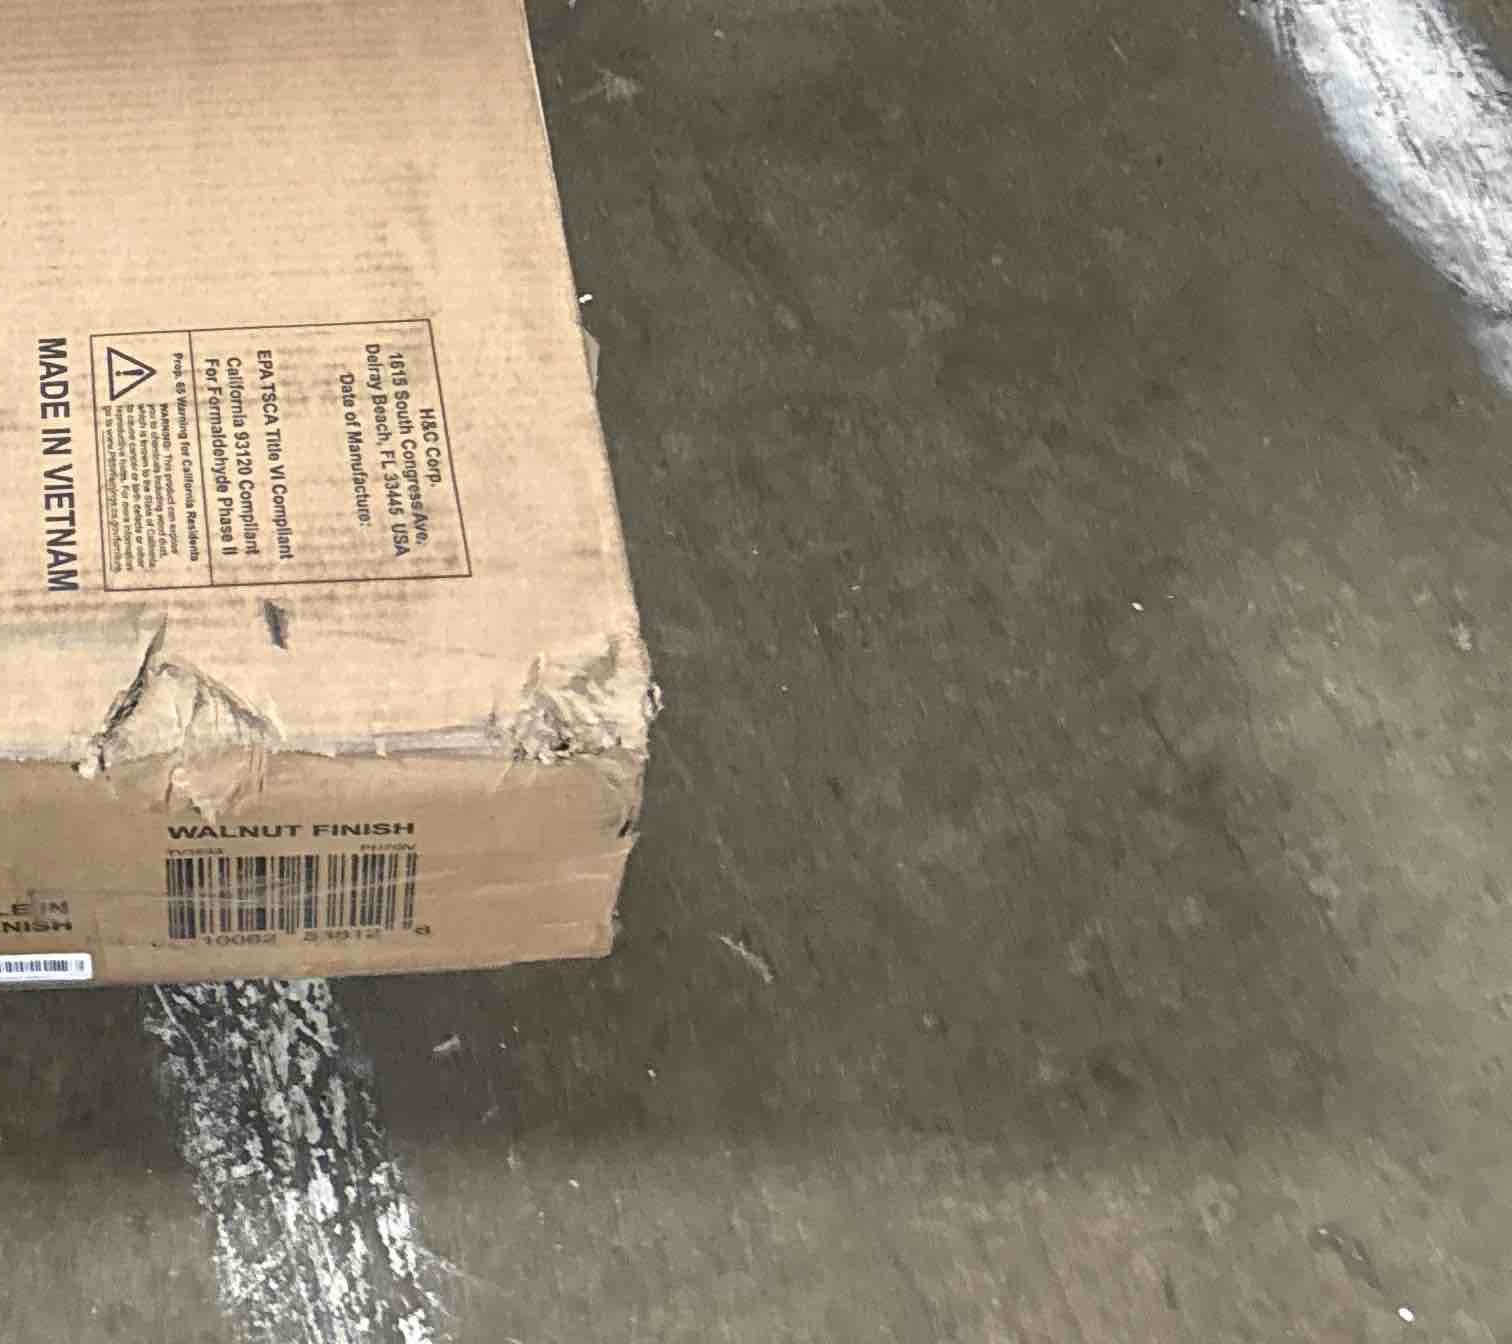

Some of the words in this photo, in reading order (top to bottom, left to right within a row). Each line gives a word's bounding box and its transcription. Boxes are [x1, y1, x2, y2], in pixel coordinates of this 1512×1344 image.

[38, 337, 70, 419] MADE
[172, 352, 184, 380] Prop.
[205, 358, 220, 384] For
[257, 349, 272, 380] EPA
[365, 344, 382, 392] Delray
[388, 352, 408, 387] 1615
[175, 382, 186, 395] 65
[227, 357, 246, 428] California
[259, 382, 279, 426] TSCA
[339, 373, 357, 407] Date
[176, 397, 188, 440] Warning
[345, 410, 361, 427] of
[371, 394, 389, 446] Beach,
[394, 390, 410, 435] South
[420, 408, 439, 443] H&C
[41, 427, 72, 456] IN
[180, 442, 191, 456] for
[208, 386, 230, 493] Formaldehyde
[234, 431, 253, 476] 93120
[266, 428, 283, 462] Title
[380, 449, 395, 470] FL
[182, 459, 195, 511] California
[268, 465, 286, 481] VI
[347, 431, 370, 528] Manufacture:
[400, 439, 423, 510] Congress
[425, 445, 442, 488] Corp.
[383, 472, 404, 516] 33445
[44, 463, 79, 592] VIETNAM
[187, 512, 200, 562] Residents
[217, 497, 234, 542] Phase
[238, 478, 260, 555] Compliant
[271, 483, 294, 560] Compliant
[412, 512, 429, 545] Ave.
[222, 546, 237, 556] II
[391, 523, 411, 557] USA
[168, 824, 302, 840] WALNUT
[312, 822, 415, 837] FINISH
[40, 900, 69, 915] IN
